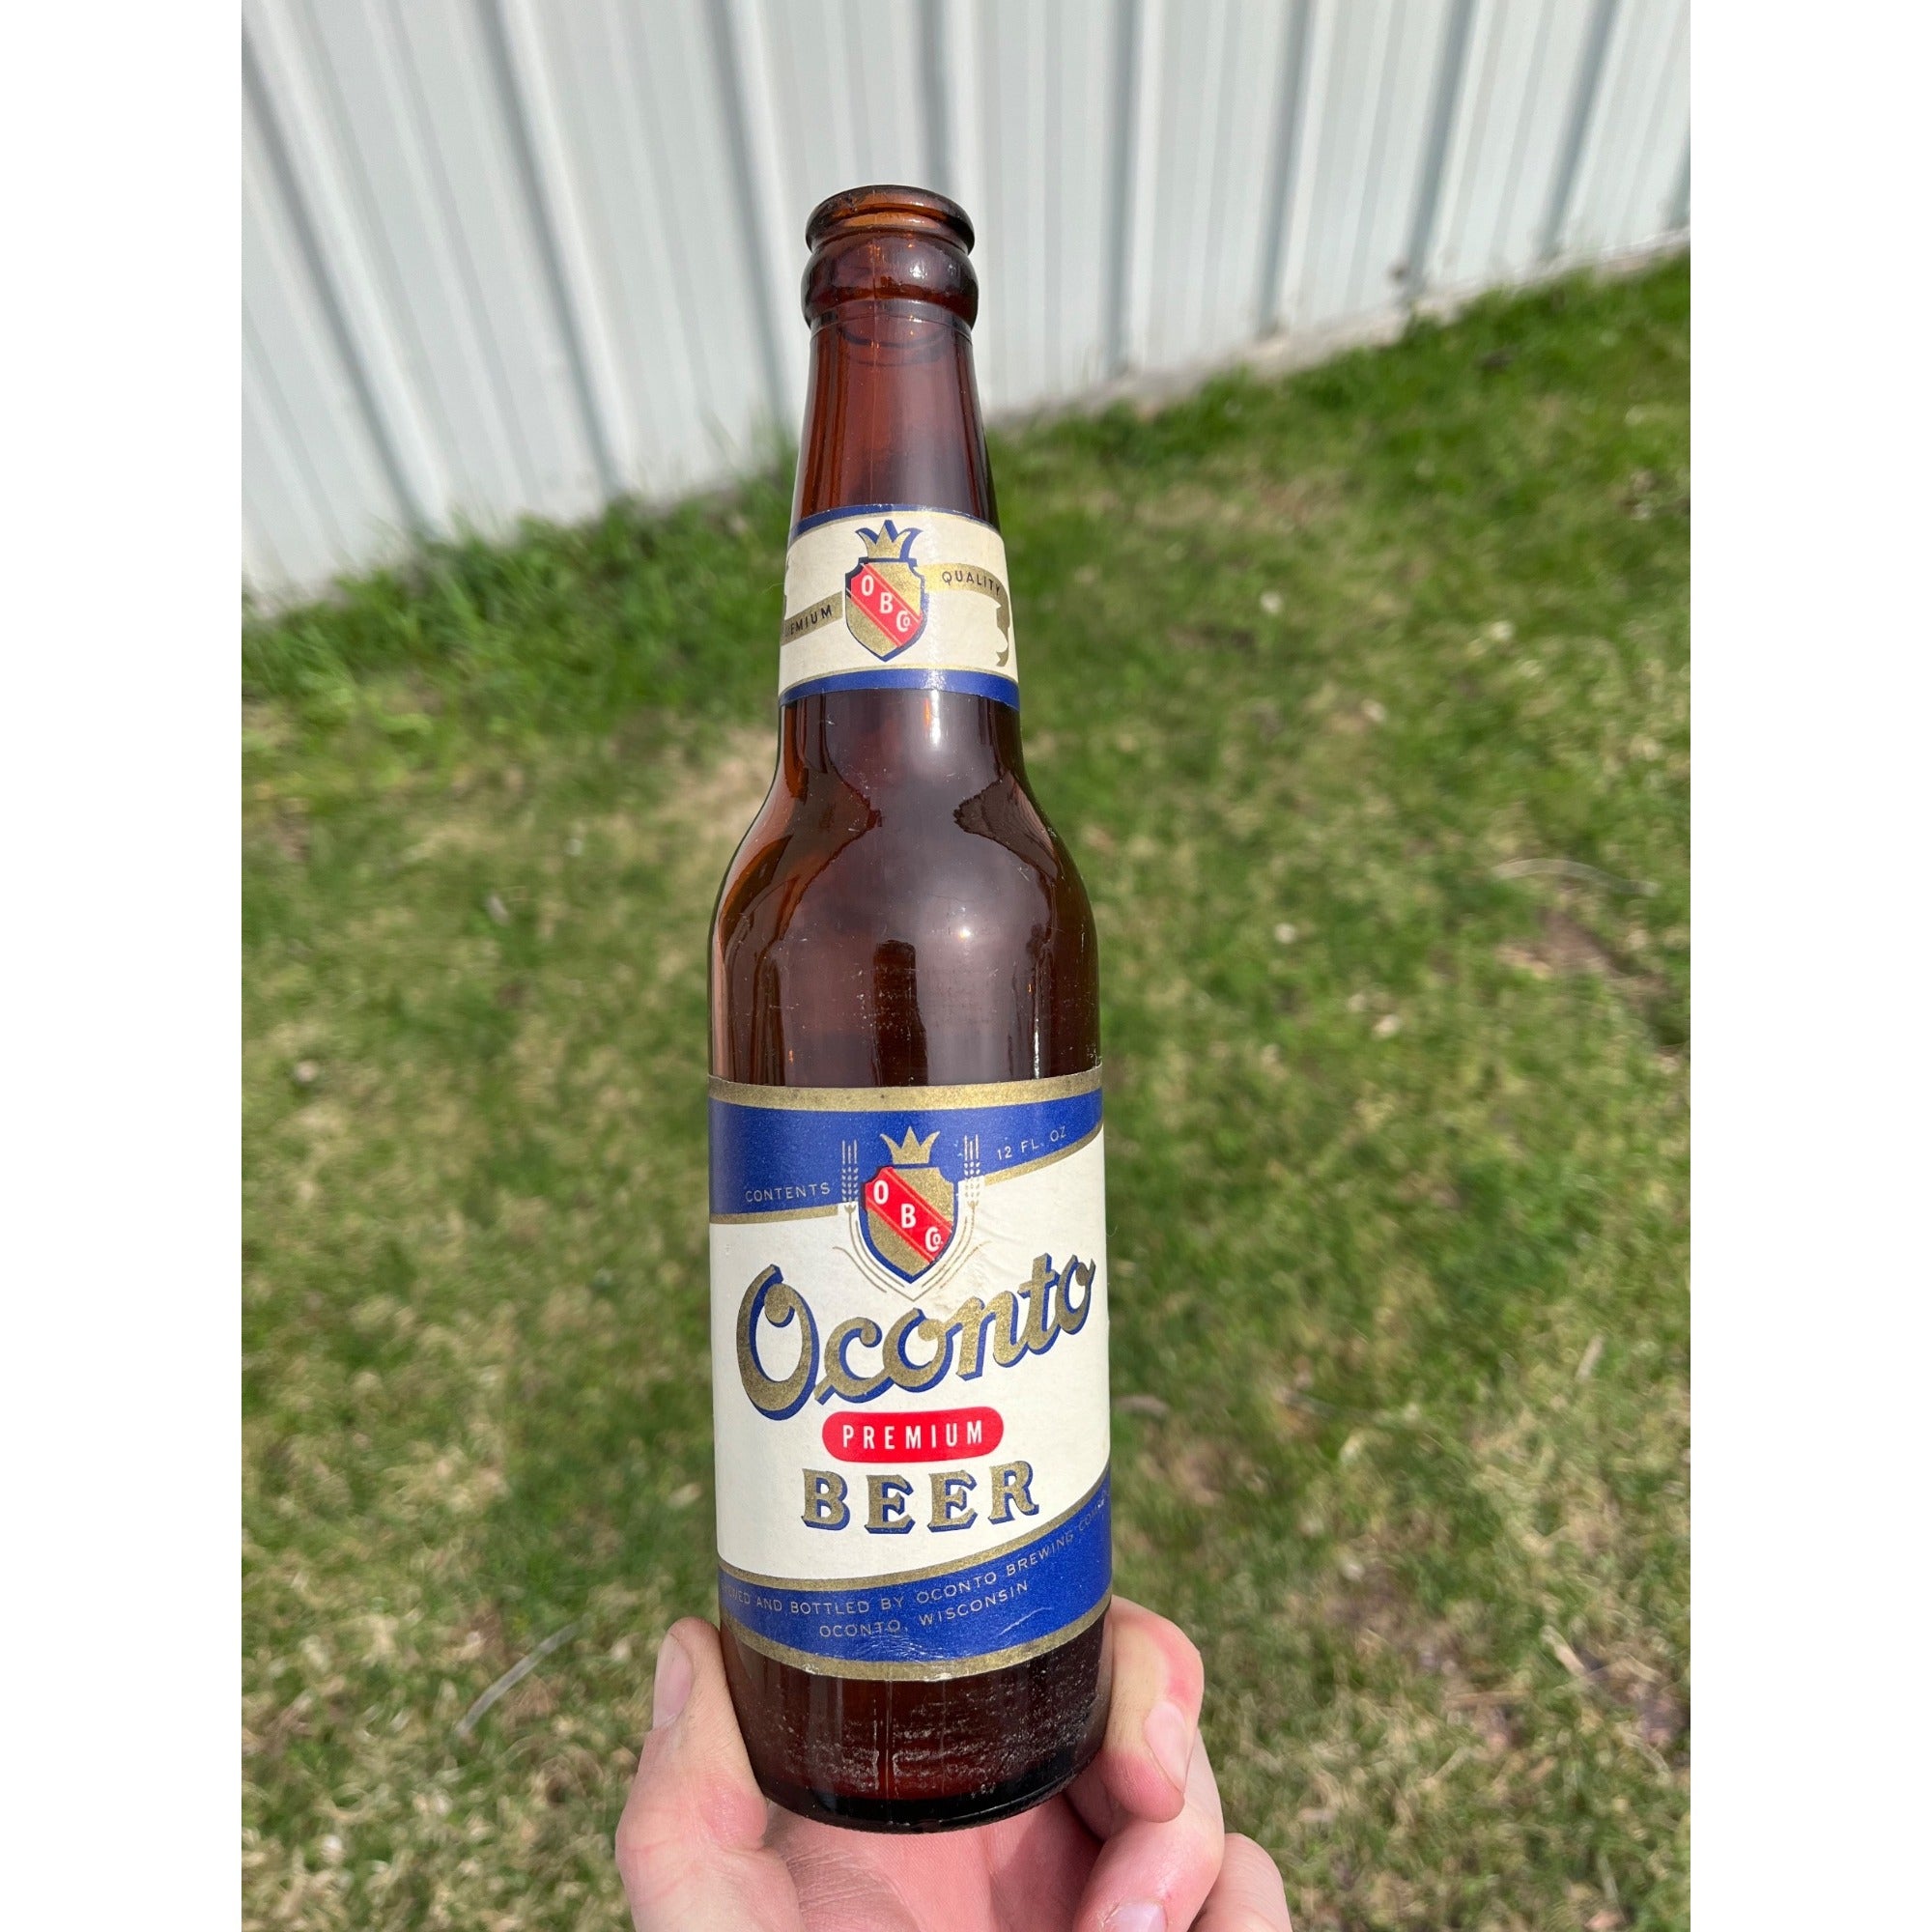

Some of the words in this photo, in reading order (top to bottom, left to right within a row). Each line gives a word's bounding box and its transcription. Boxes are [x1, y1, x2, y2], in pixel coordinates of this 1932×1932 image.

[861, 575, 874, 596] O
[880, 592, 894, 613] B
[942, 571, 1000, 596] QUALITY
[784, 604, 833, 637] EMIUM
[997, 1146, 1012, 1160] 12
[745, 1181, 831, 1203] CONTENTS
[873, 1179, 889, 1206] O
[900, 1203, 917, 1229] B
[736, 1254, 1096, 1421] Oconto
[842, 1420, 982, 1449] PREMIUM
[801, 1461, 1039, 1535] BEER
[755, 1597, 782, 1612] AND
[790, 1601, 869, 1615] BOTTLED
[880, 1597, 904, 1610] BY
[916, 1572, 997, 1604] OCONTO
[1006, 1529, 1073, 1577] BREWING
[919, 1579, 1028, 1627] WISCONSIN
